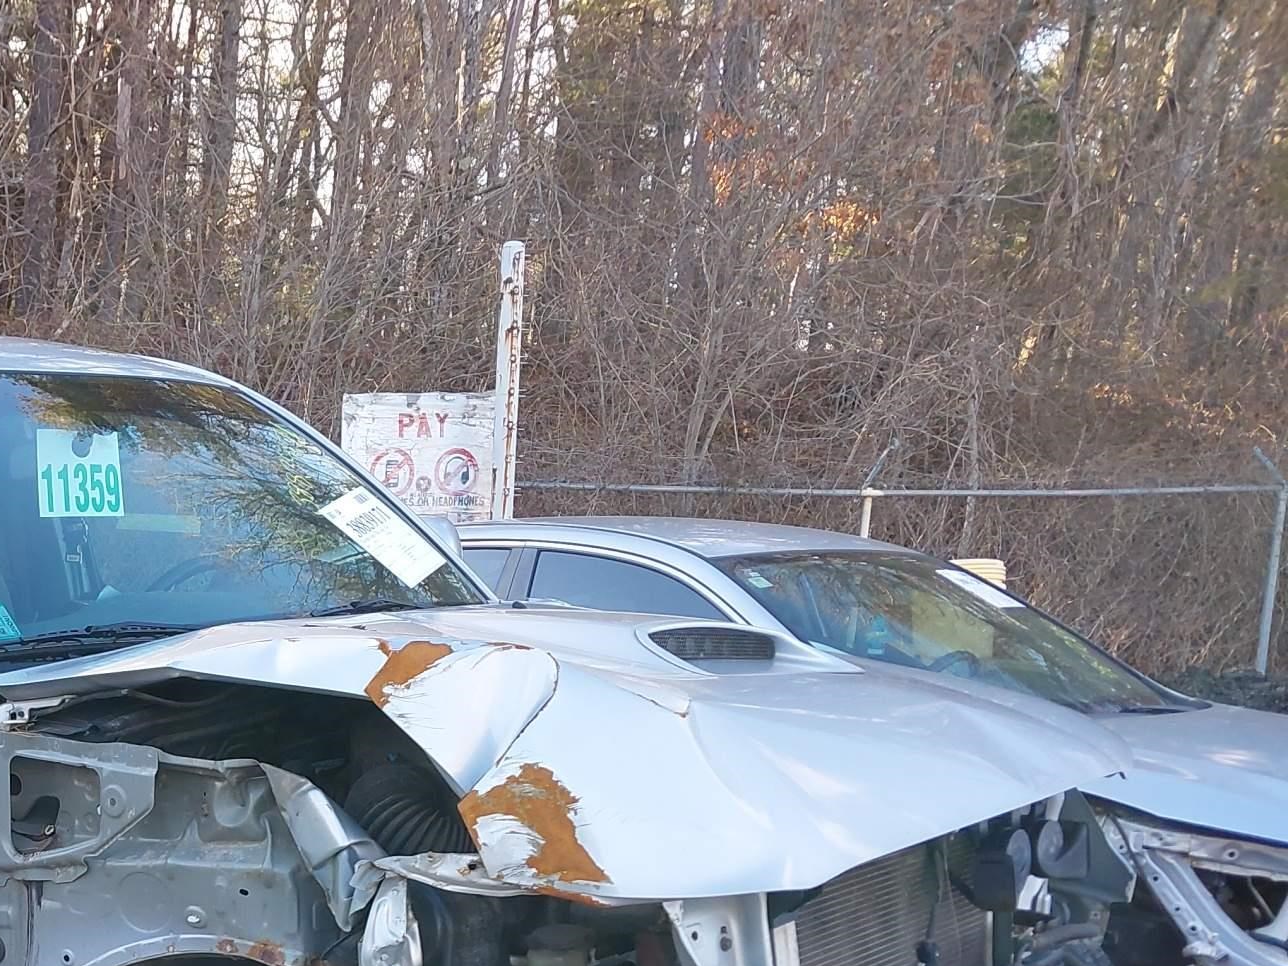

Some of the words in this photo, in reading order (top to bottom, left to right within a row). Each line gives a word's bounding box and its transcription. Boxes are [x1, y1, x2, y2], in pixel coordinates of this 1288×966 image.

[398, 413, 449, 438] PAY
[41, 463, 120, 512] 11359
[432, 495, 485, 507] HEADPHONES
